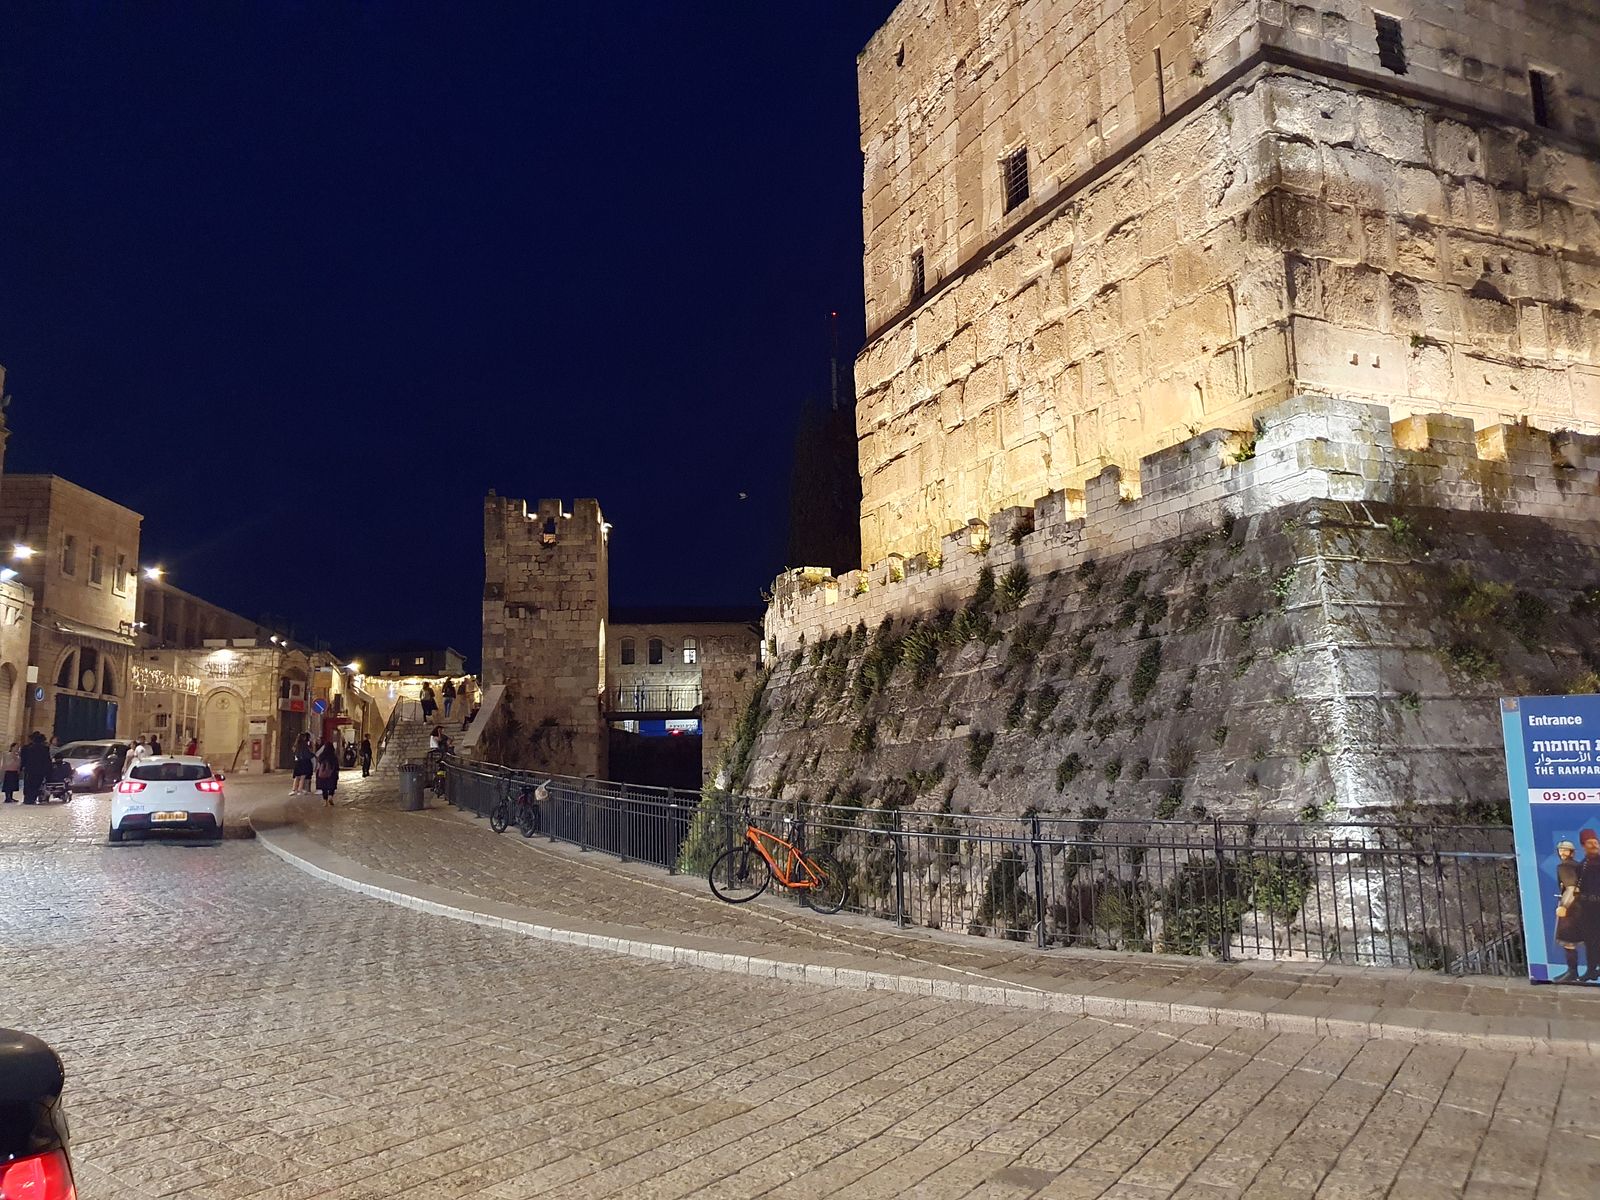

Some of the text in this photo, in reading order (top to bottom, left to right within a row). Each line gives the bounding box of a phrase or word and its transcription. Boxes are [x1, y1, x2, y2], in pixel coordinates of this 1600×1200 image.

[1528, 714, 1582, 726] Entrance
[1532, 739, 1591, 752] החומות
[1534, 751, 1591, 766] الأسوار
[1534, 766, 1555, 775] THE
